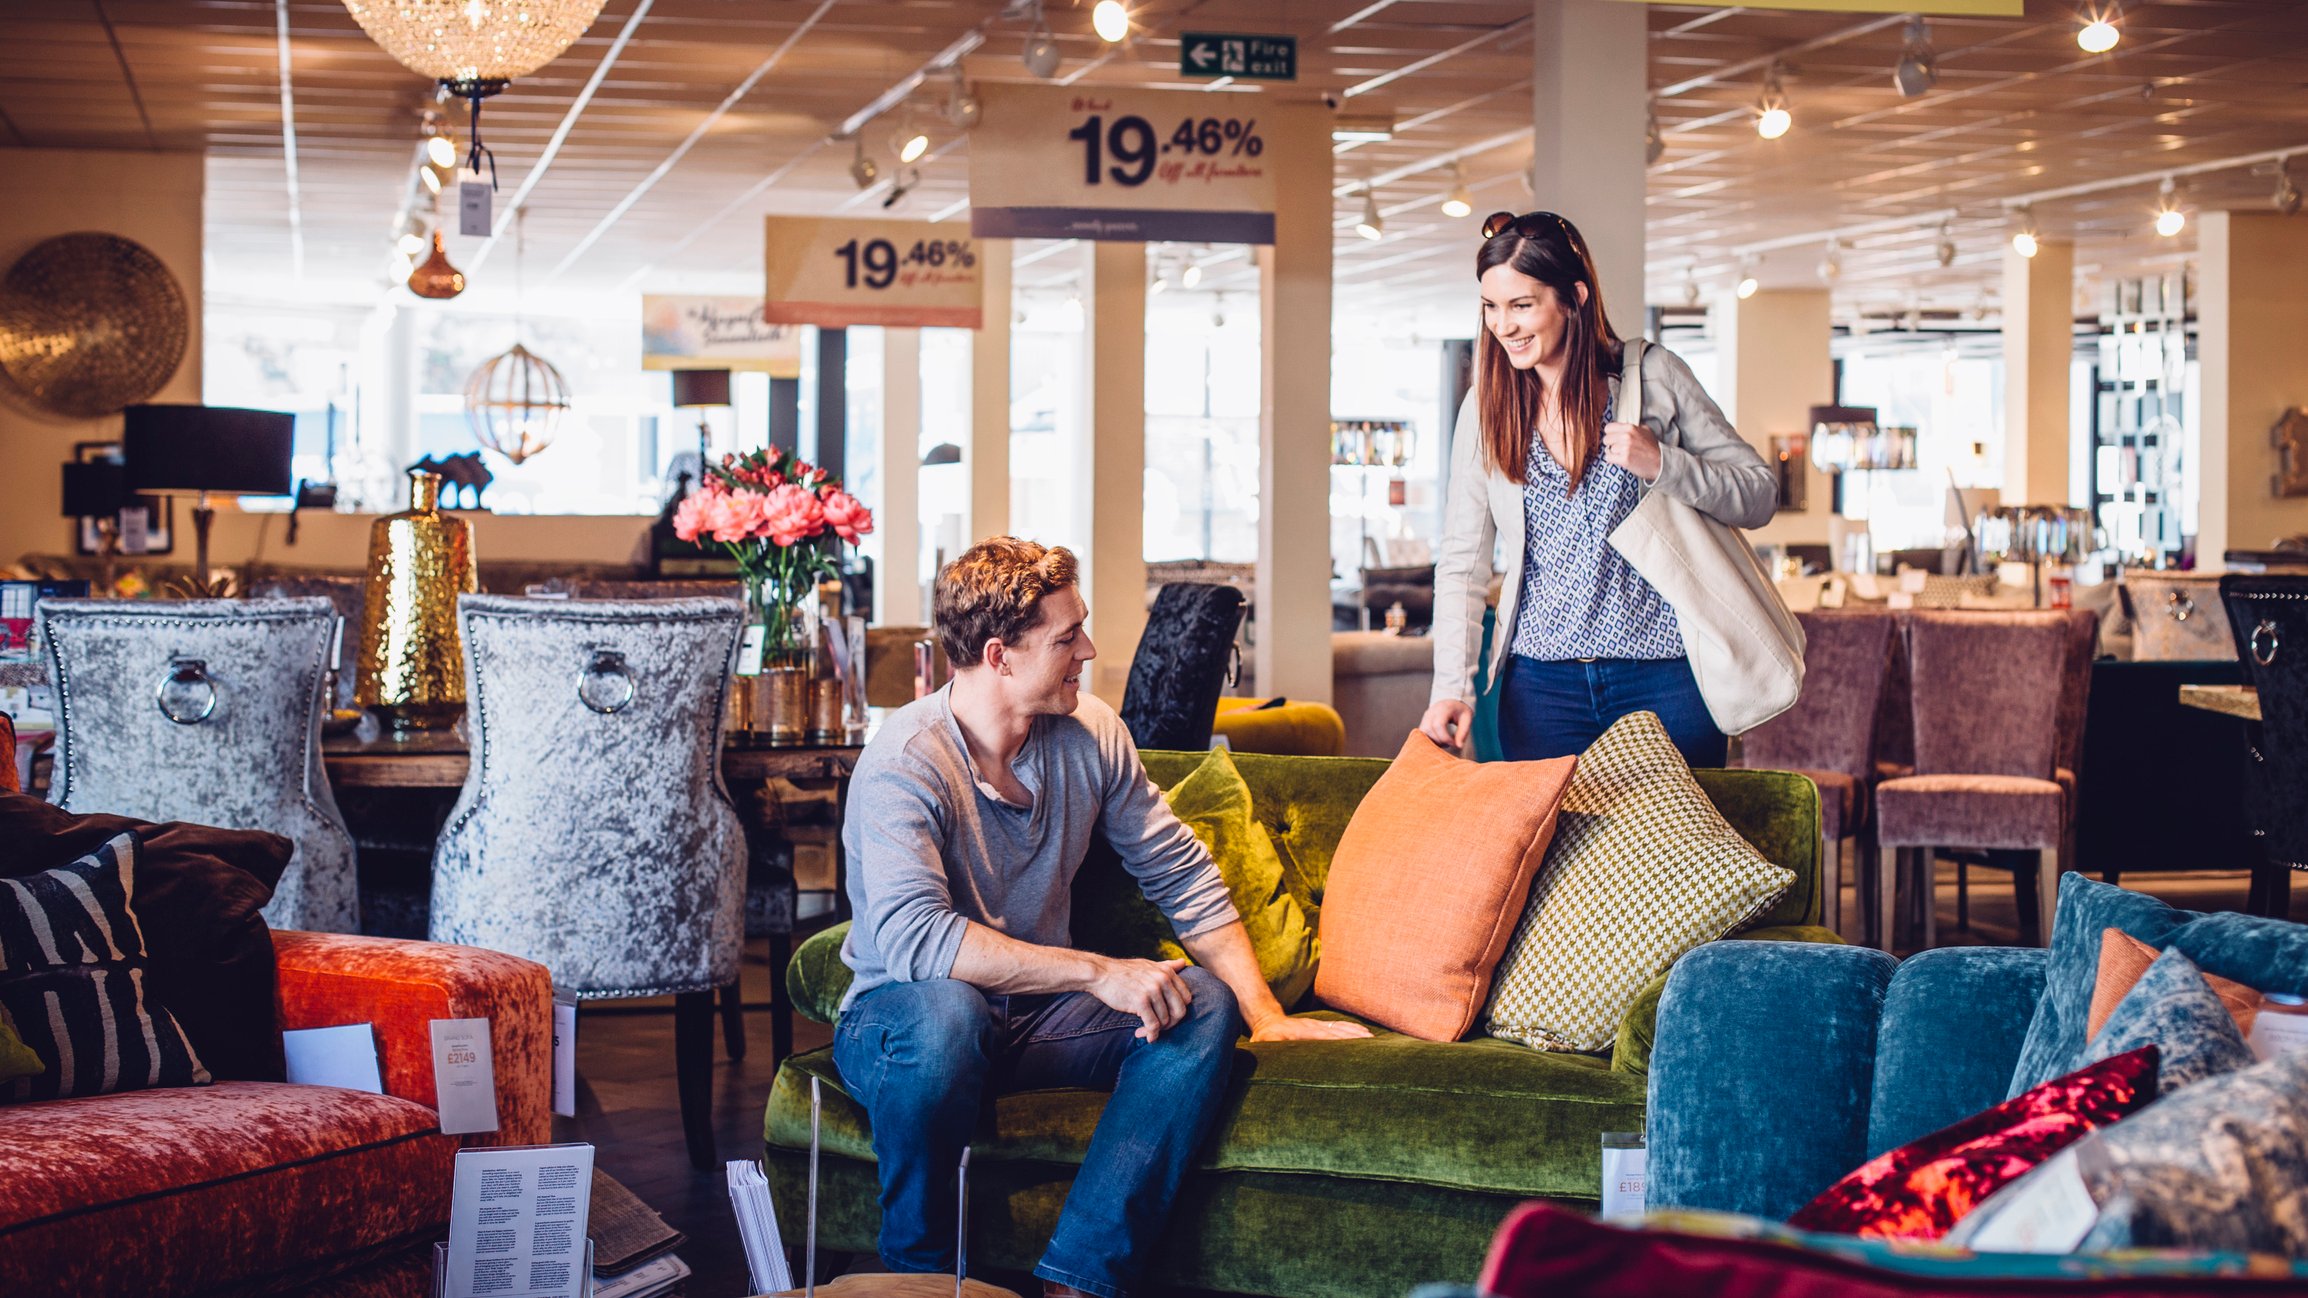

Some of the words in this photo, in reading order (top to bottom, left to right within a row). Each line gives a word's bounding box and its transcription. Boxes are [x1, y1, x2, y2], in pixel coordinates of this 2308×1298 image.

[1250, 40, 1289, 55] Fire
[1251, 61, 1287, 74] exit
[448, 1051, 476, 1065] £2149
